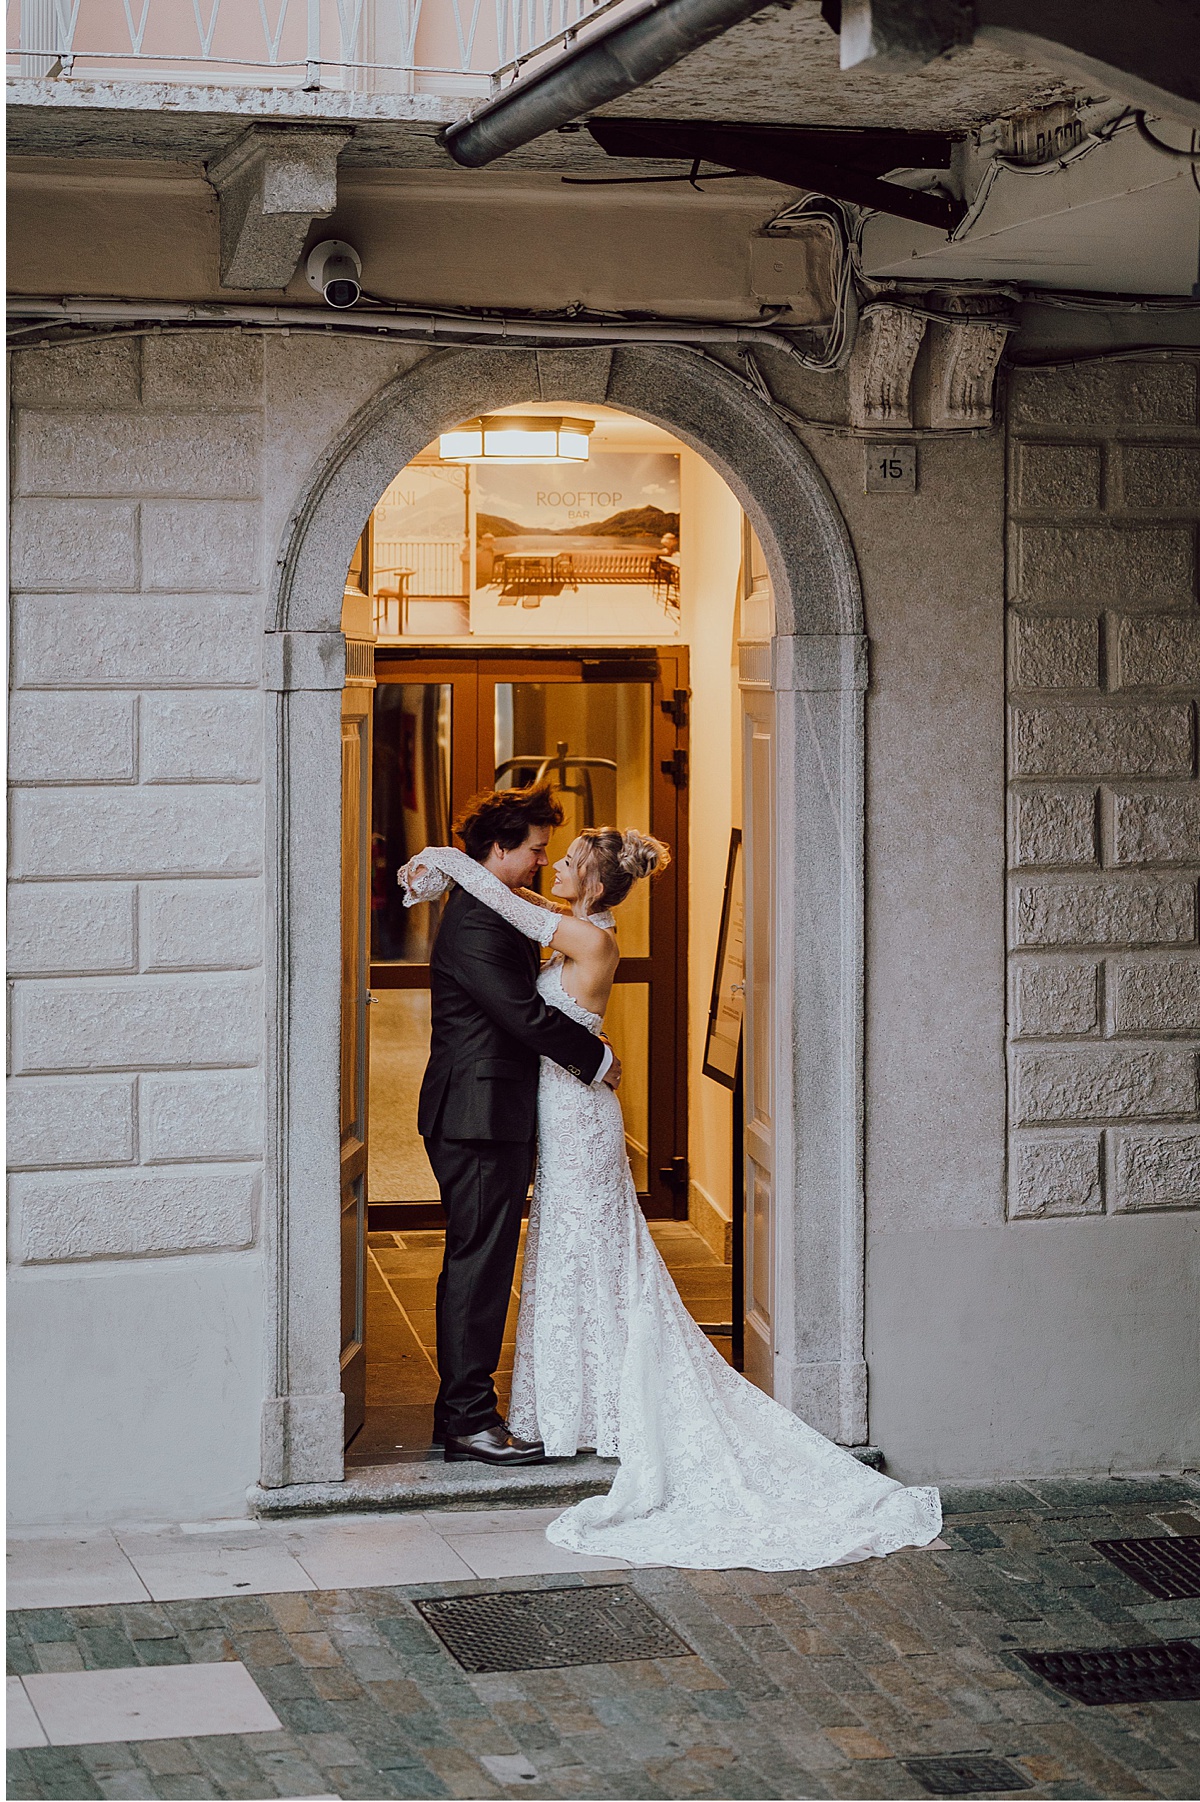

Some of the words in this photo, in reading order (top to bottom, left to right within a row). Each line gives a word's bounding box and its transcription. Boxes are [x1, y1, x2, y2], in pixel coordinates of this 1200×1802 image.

[879, 459, 903, 480] 15
[536, 491, 623, 507] ROOFTOP
[567, 510, 590, 519] BAR
